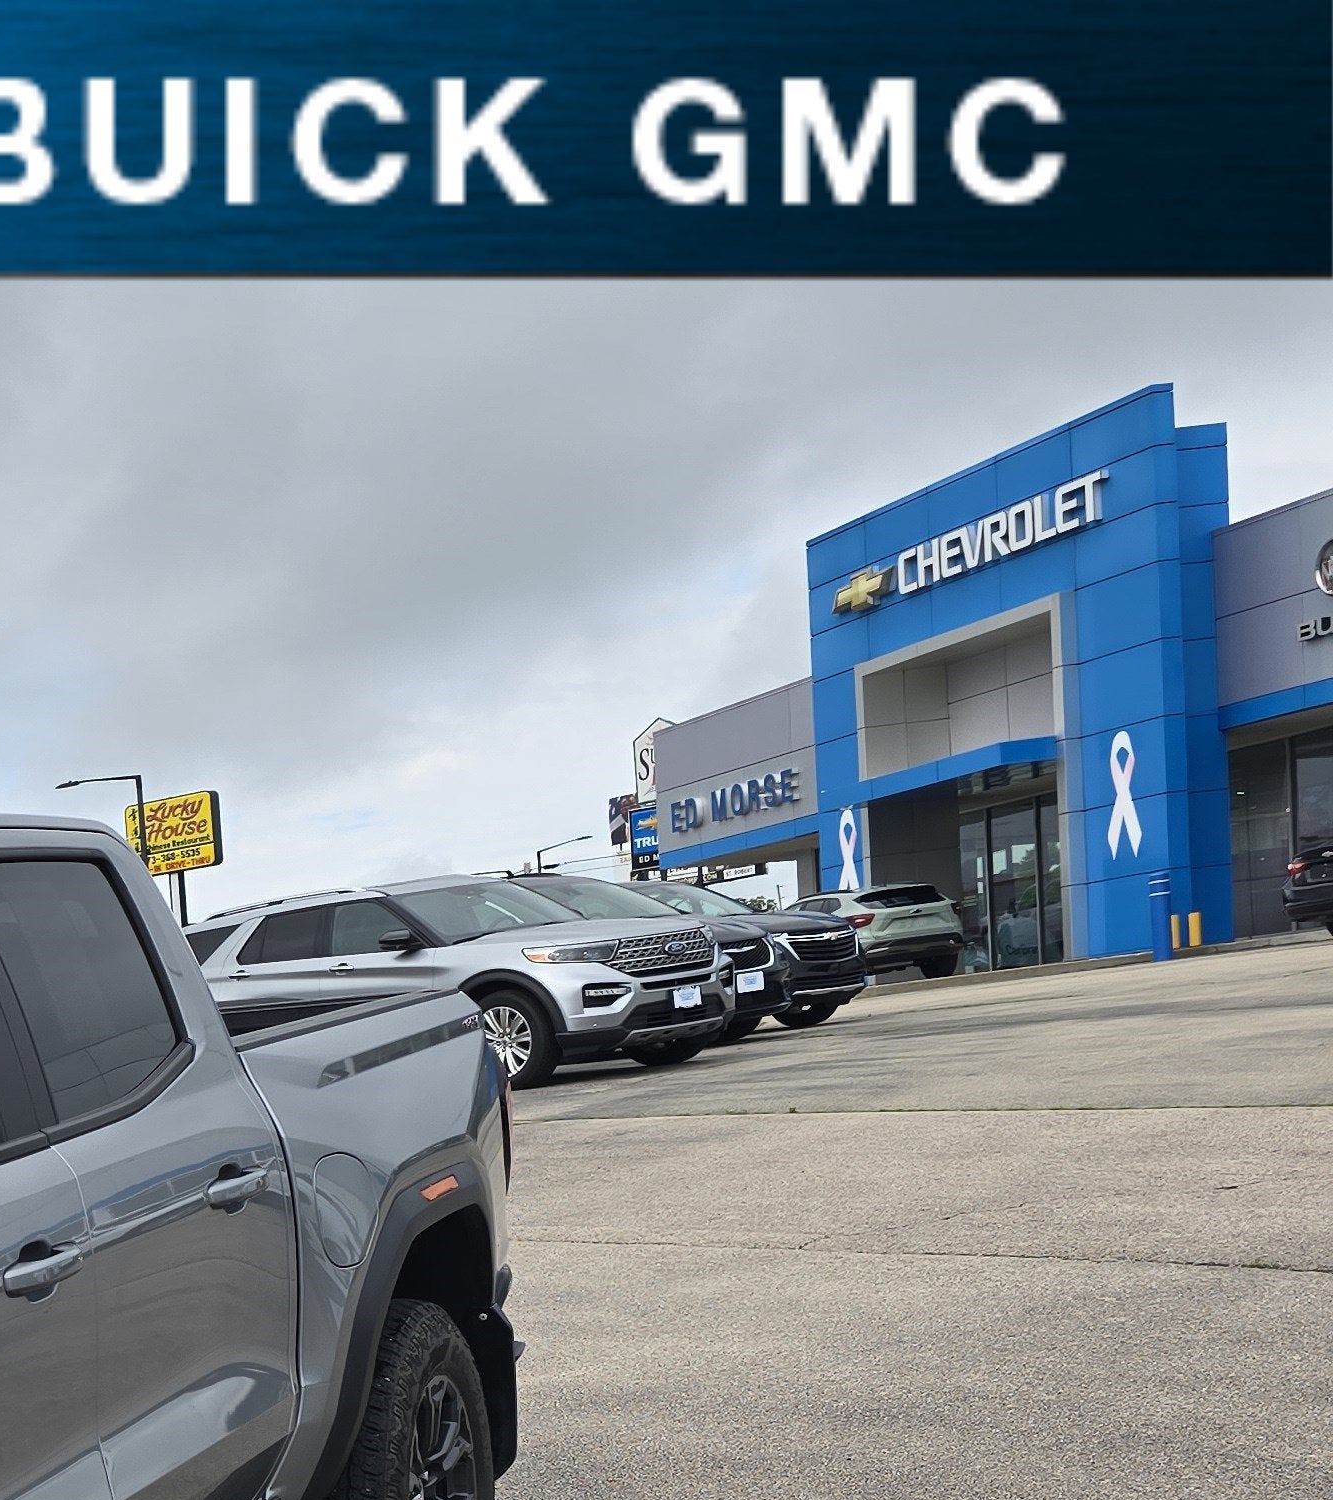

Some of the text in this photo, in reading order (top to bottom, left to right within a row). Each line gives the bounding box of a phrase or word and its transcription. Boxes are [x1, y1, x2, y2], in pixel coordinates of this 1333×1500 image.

[897, 470, 1106, 595] CHEVROLET
[1298, 616, 1333, 641] BU
[146, 799, 204, 822] Lucky
[671, 768, 798, 833] ED MORSE
[145, 819, 208, 842] House
[634, 836, 658, 849] TRU
